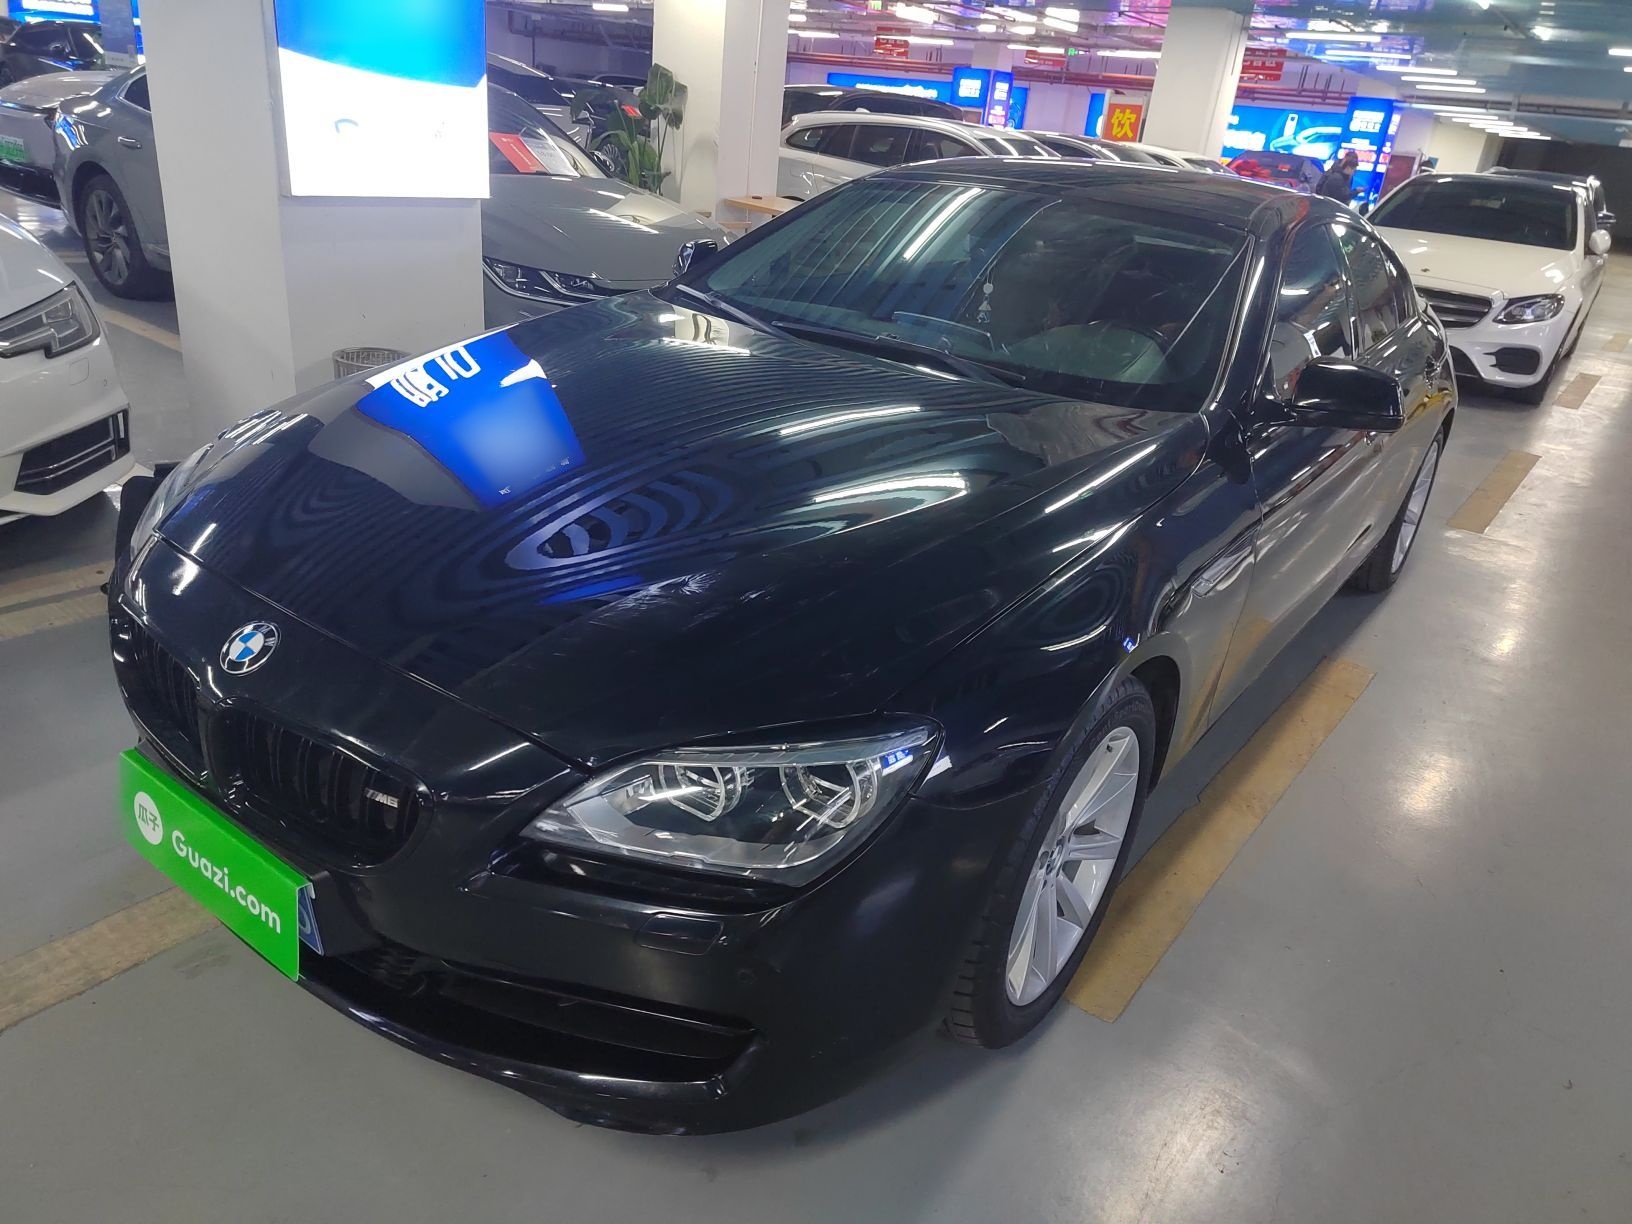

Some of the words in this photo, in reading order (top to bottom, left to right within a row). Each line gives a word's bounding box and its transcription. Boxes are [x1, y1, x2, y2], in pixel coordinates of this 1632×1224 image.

[1111, 108, 1137, 139] 饮
[138, 803, 162, 832] 瓜子
[171, 830, 281, 934] Guazi.com
